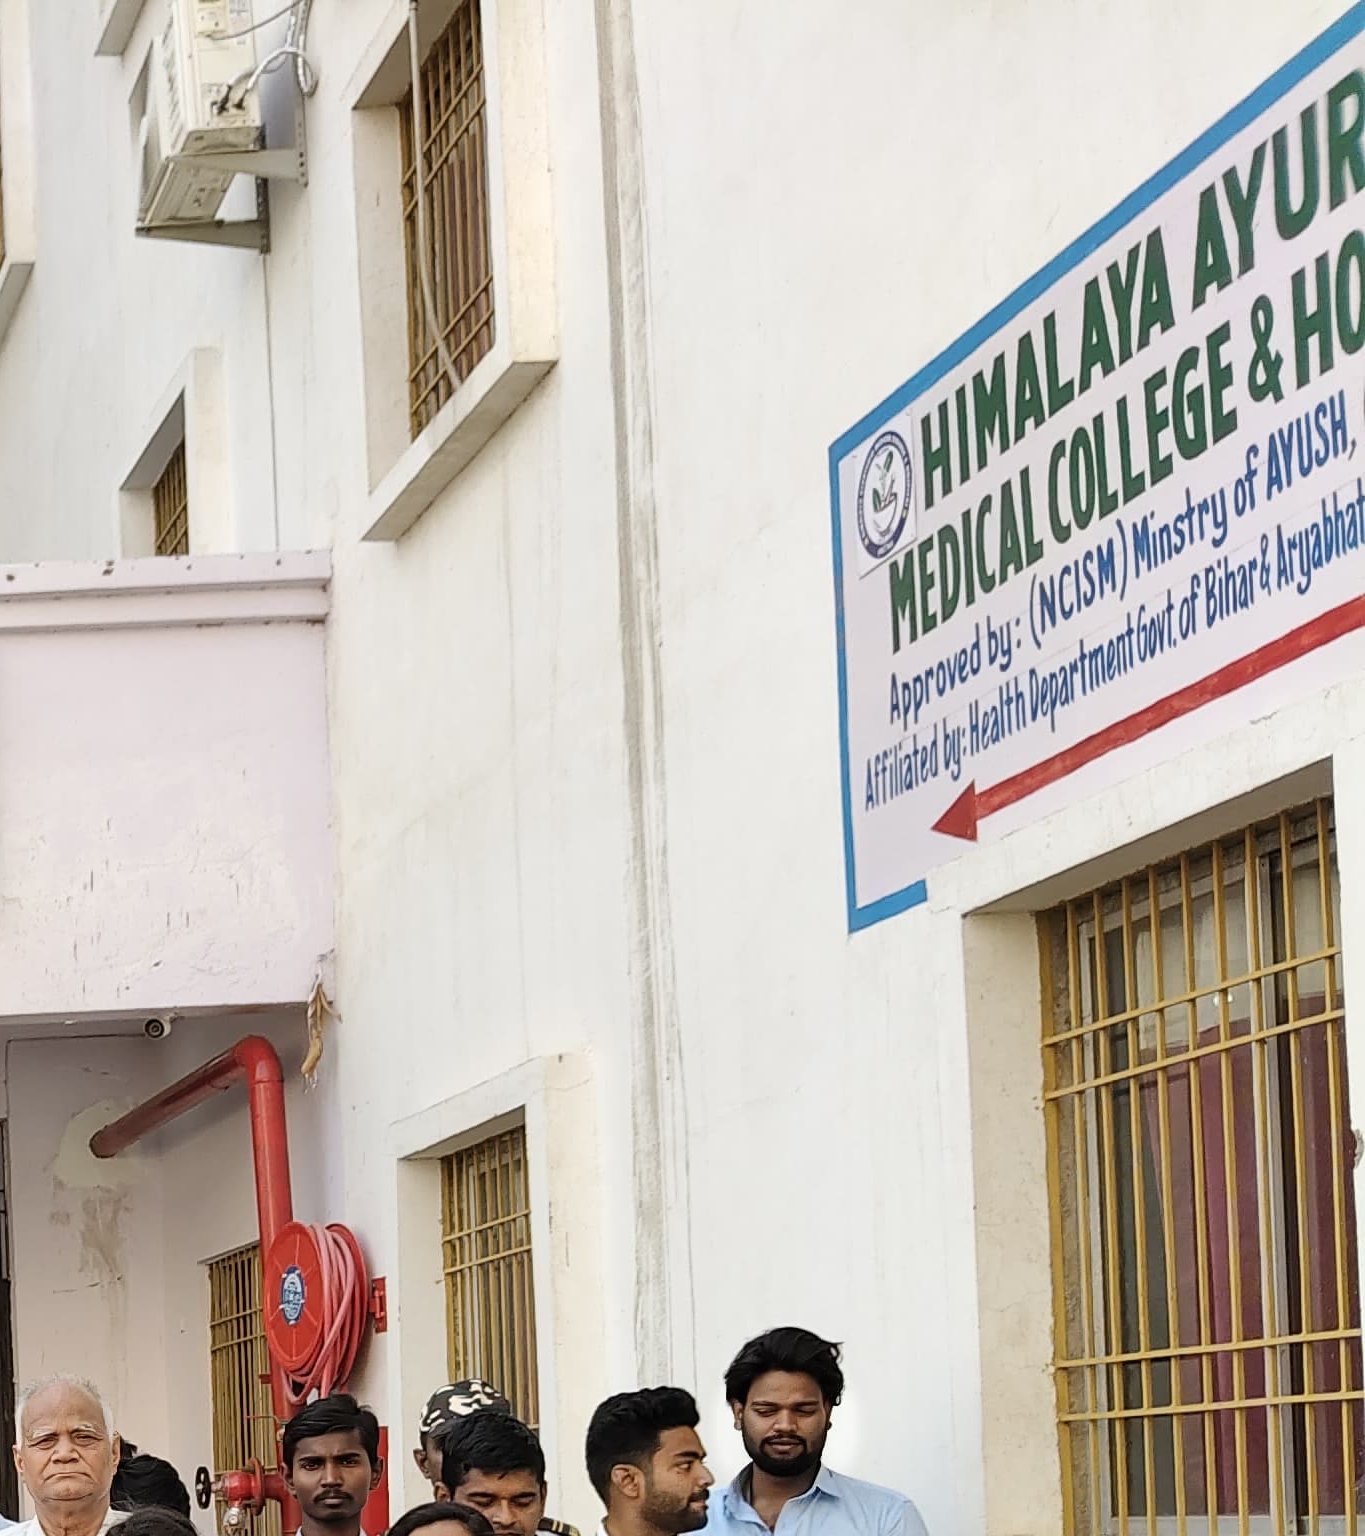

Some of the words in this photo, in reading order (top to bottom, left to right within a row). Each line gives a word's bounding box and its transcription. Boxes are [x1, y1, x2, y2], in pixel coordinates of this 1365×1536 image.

[889, 466, 1043, 654] MEDICAL
[1048, 320, 1237, 544] COLLEGE
[1247, 295, 1284, 403] &
[1291, 228, 1365, 391] HO
[921, 225, 1175, 510] HIMALAYA
[1191, 67, 1365, 313] AYUR
[866, 722, 938, 812] Affiliated
[943, 717, 968, 782] by:
[970, 675, 1027, 757] Health
[1029, 612, 1134, 733] Department
[1136, 589, 1177, 663] Govt.
[1179, 574, 1200, 640] of
[1204, 555, 1257, 629] Bihar
[1259, 534, 1271, 596] &
[890, 622, 982, 732] Approved
[987, 615, 1022, 673] by:
[1030, 518, 1128, 650] (NCISM)
[1132, 487, 1228, 579] Minstry
[1234, 444, 1259, 518] of
[1267, 389, 1357, 501] AYUSH,
